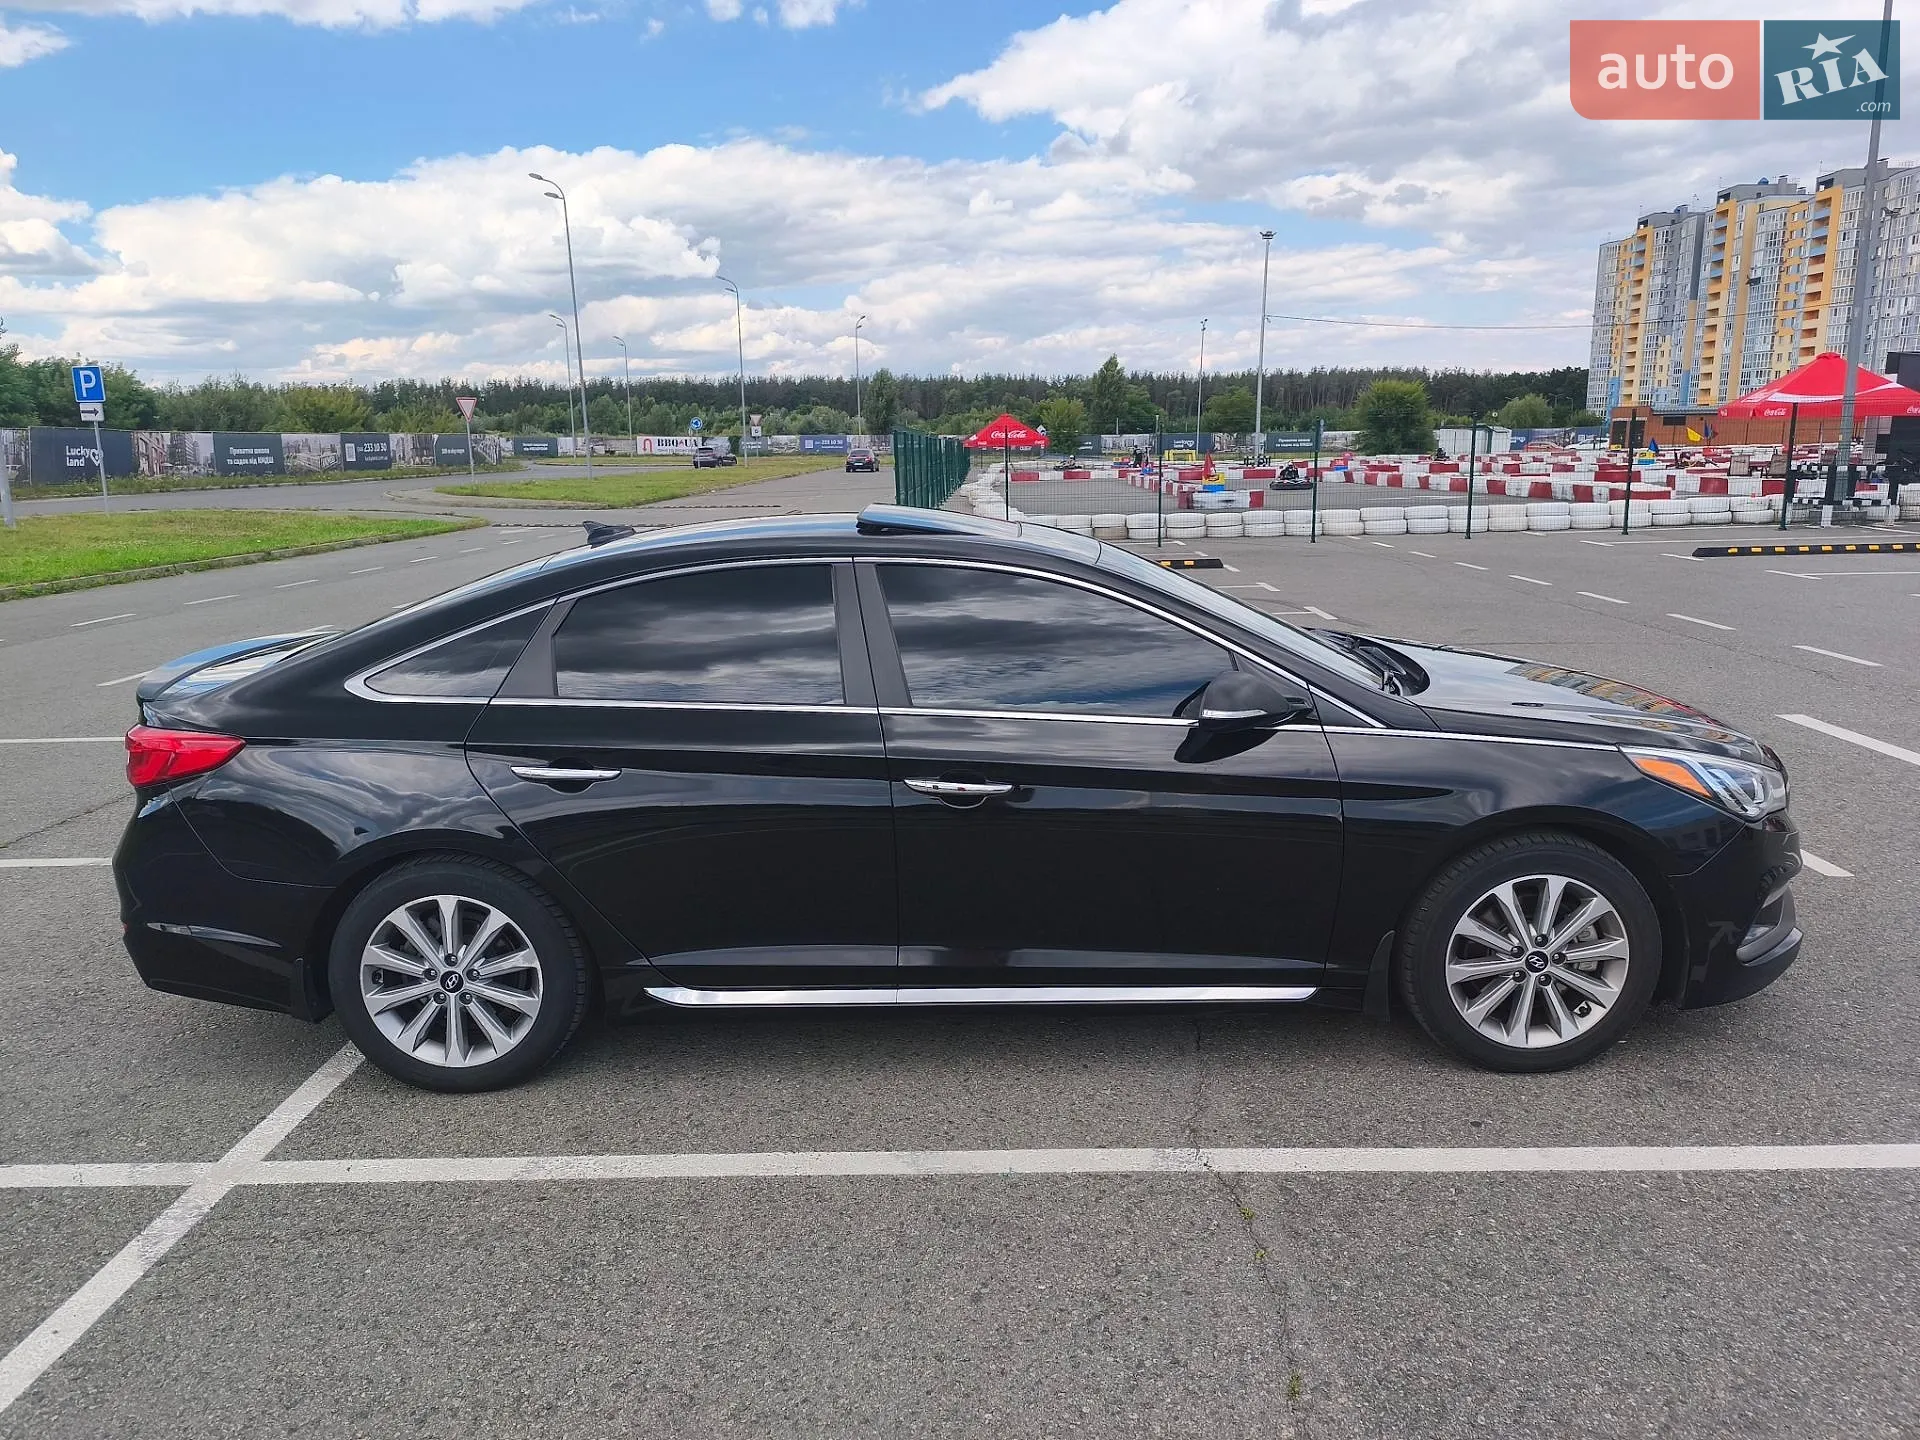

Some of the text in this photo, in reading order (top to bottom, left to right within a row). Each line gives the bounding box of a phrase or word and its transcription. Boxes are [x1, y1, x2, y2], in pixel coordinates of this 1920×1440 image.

[80, 370, 96, 398] P
[65, 445, 90, 458] Lucky
[66, 456, 85, 467] land
